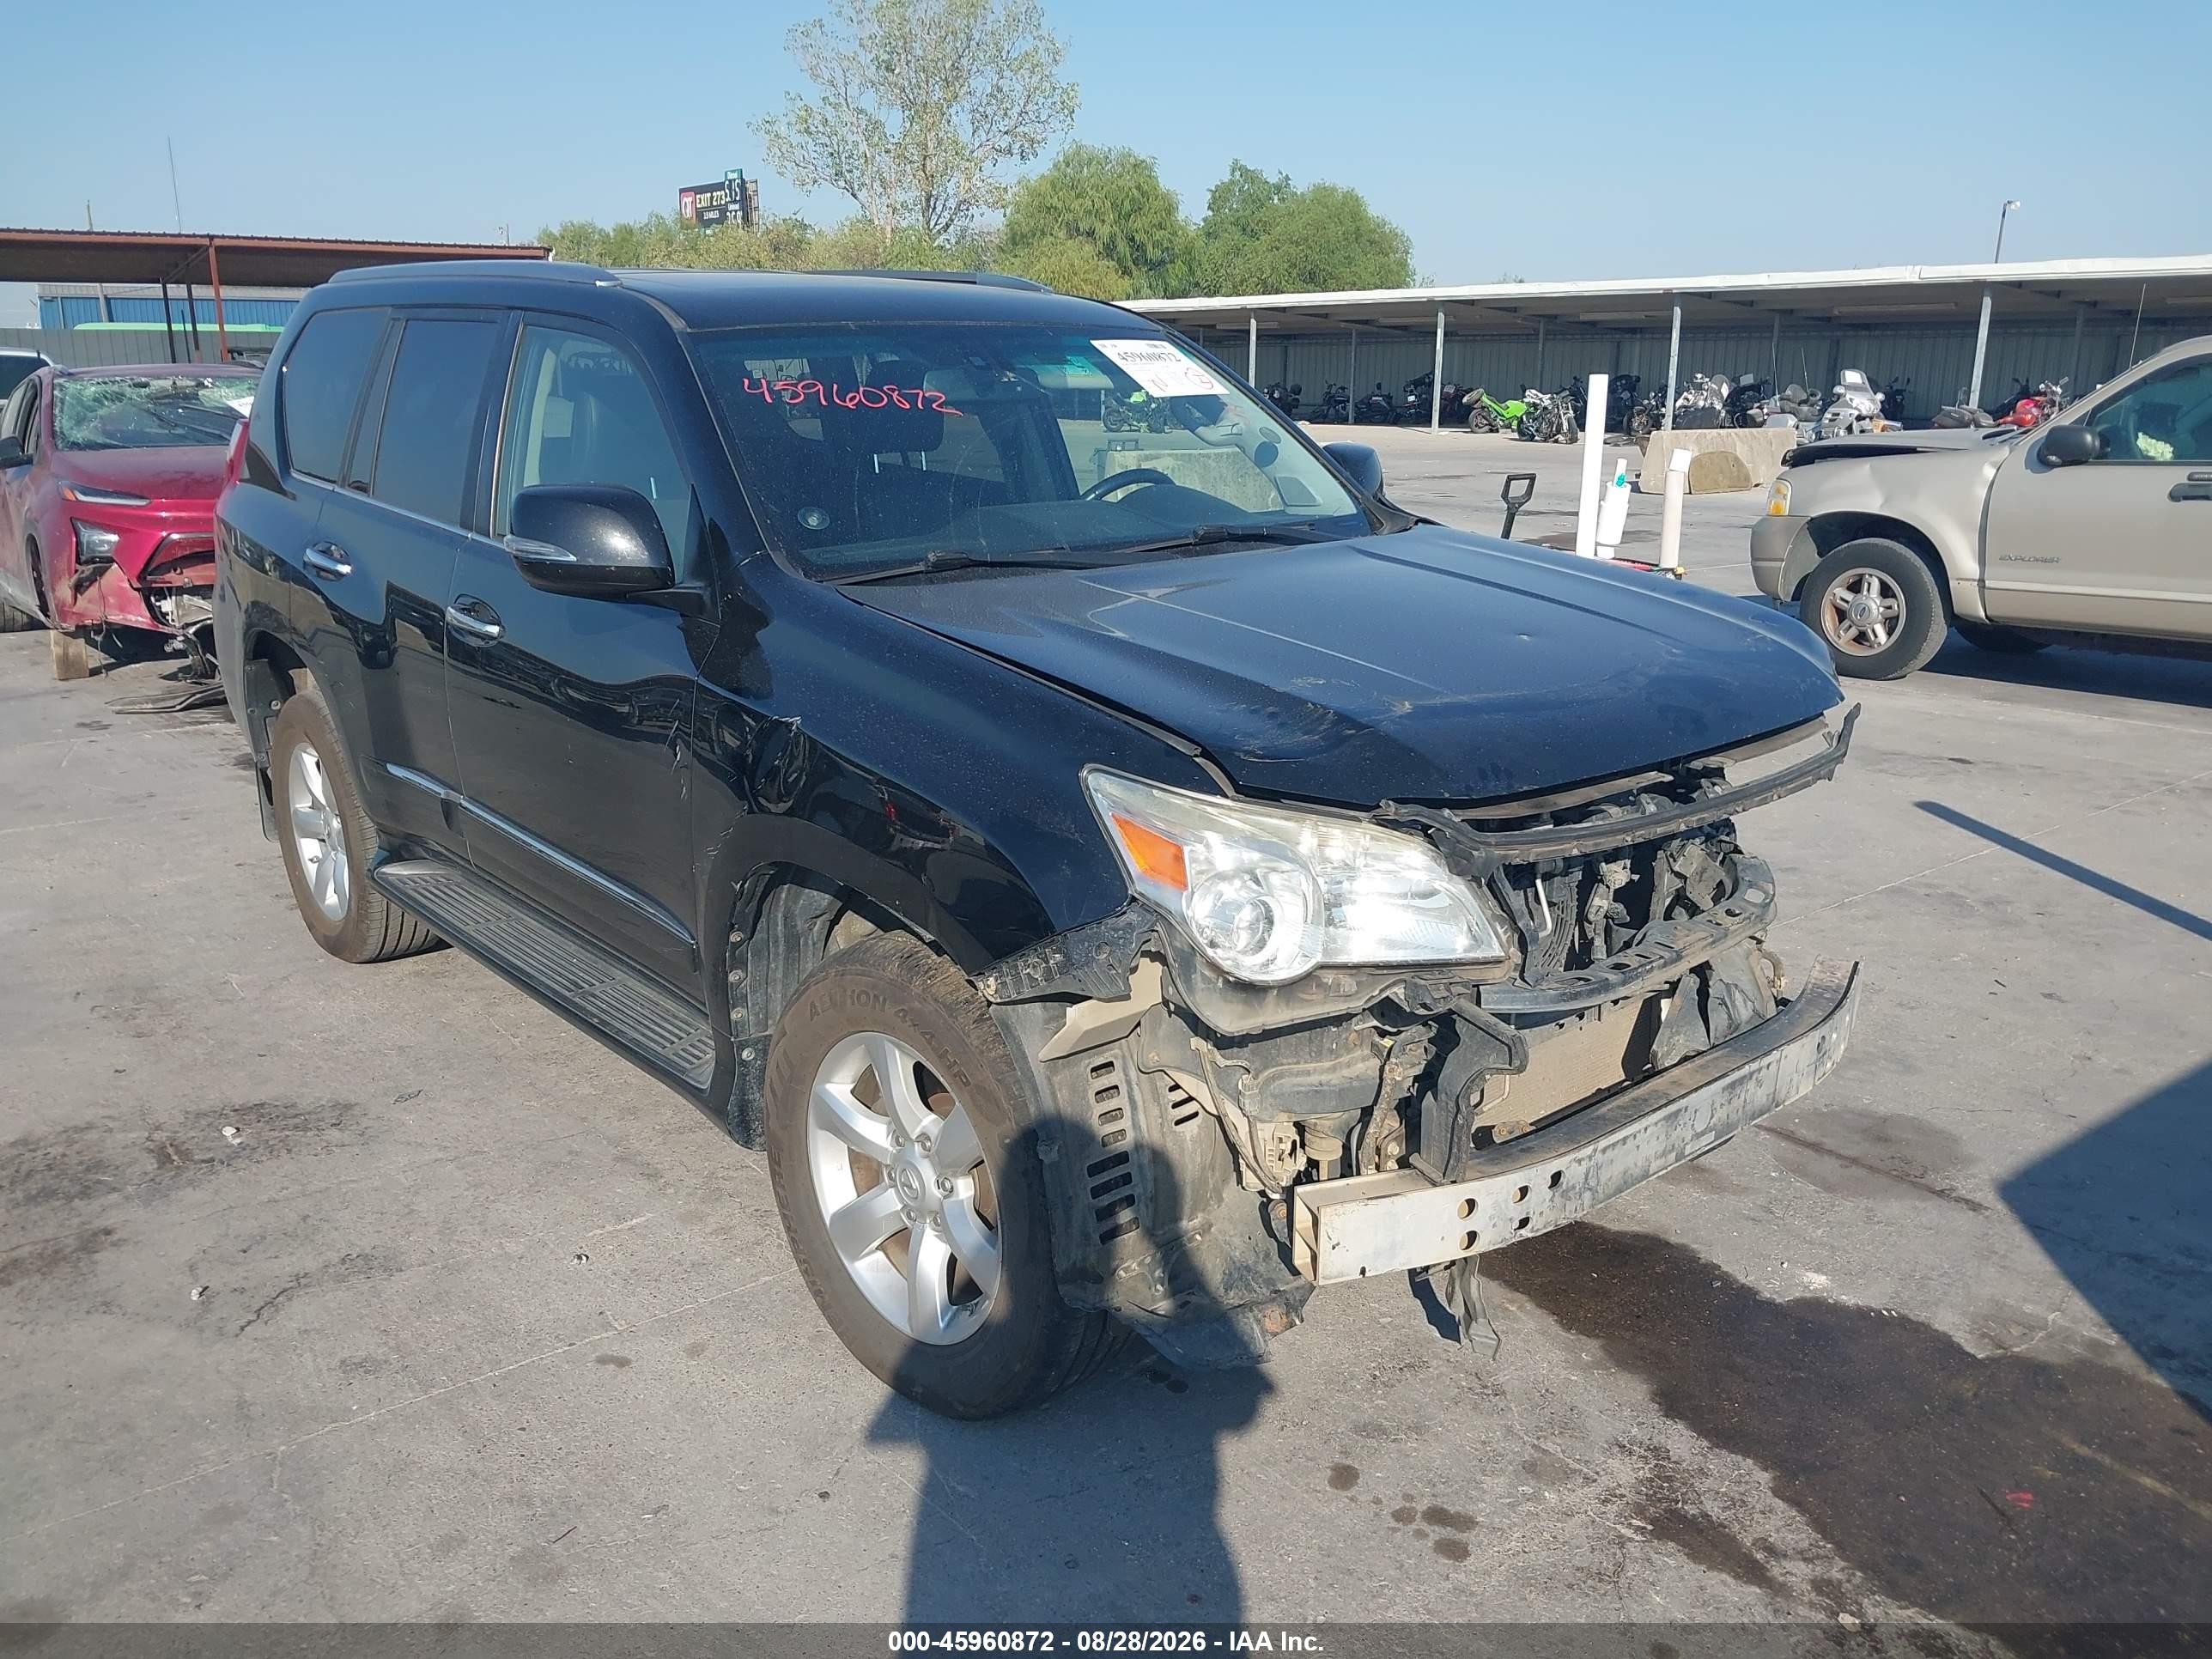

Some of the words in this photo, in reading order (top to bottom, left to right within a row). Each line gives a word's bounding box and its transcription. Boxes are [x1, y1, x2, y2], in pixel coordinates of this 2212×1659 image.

[682, 197, 692, 219] QT
[696, 192, 711, 208] EXIT
[713, 191, 726, 206] 273
[743, 378, 963, 416] 45960872
[1998, 554, 2061, 563] EXPLORER
[939, 1046, 971, 1088] HP
